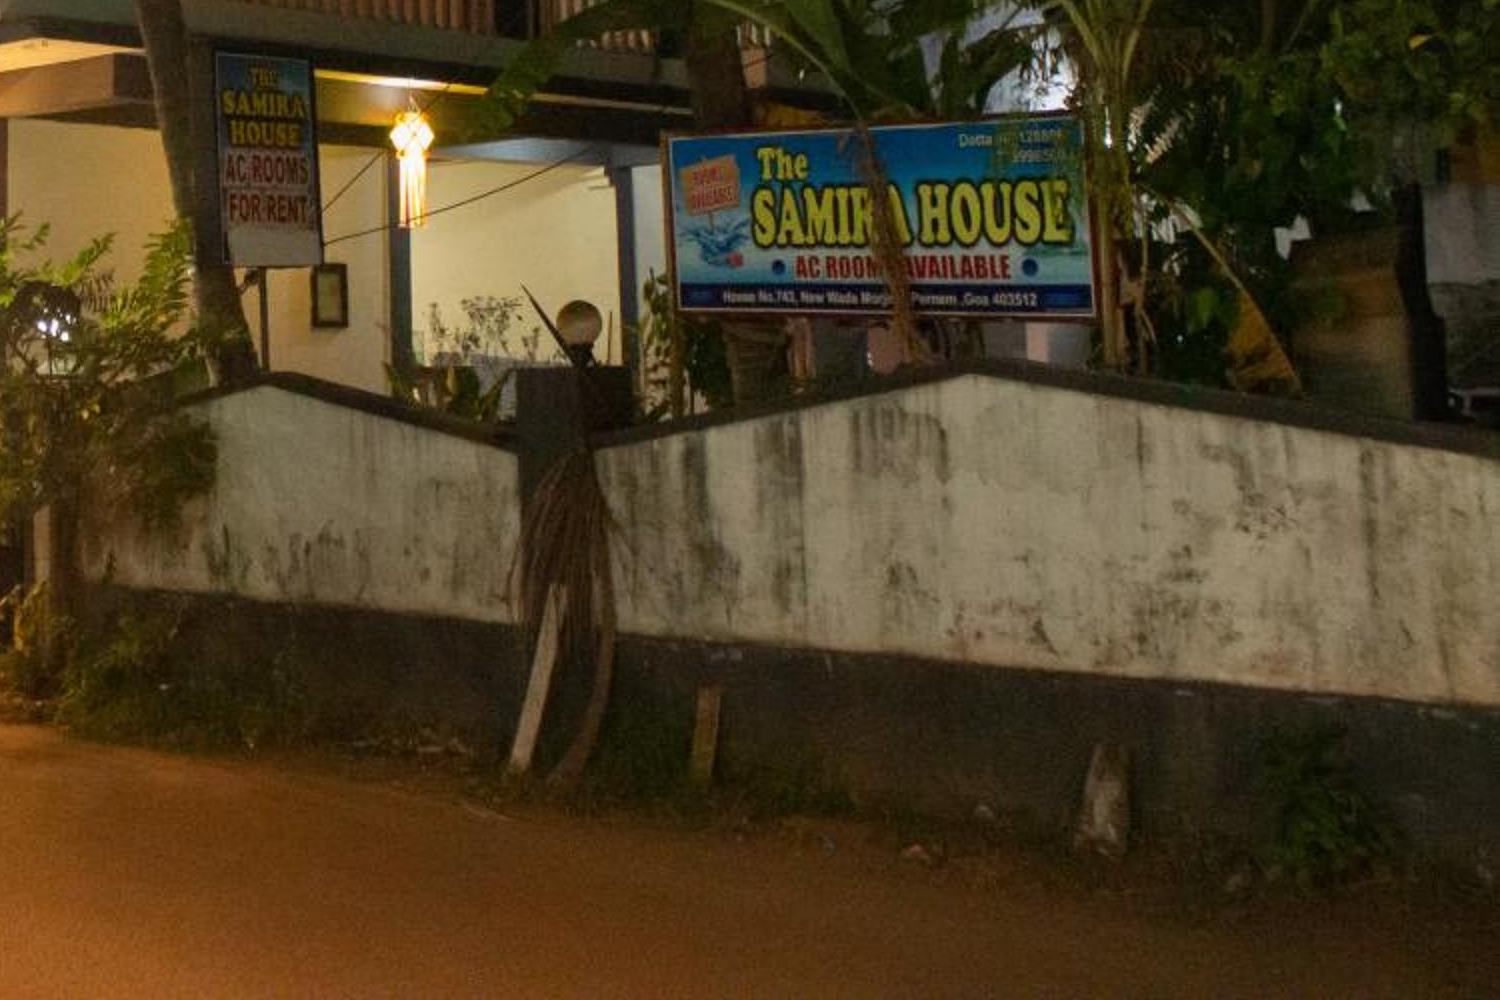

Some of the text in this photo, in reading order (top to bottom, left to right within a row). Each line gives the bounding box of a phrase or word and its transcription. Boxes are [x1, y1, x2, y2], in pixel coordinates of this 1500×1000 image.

[222, 89, 307, 119] SAMIRA
[229, 120, 301, 147] HOUSE
[226, 155, 309, 185] AC ROOMS
[757, 147, 808, 181] The
[228, 194, 308, 225] FOR RENT
[918, 179, 1073, 245] HOUSE
[796, 255, 821, 279] AC
[905, 255, 1012, 281] AVAILABLE
